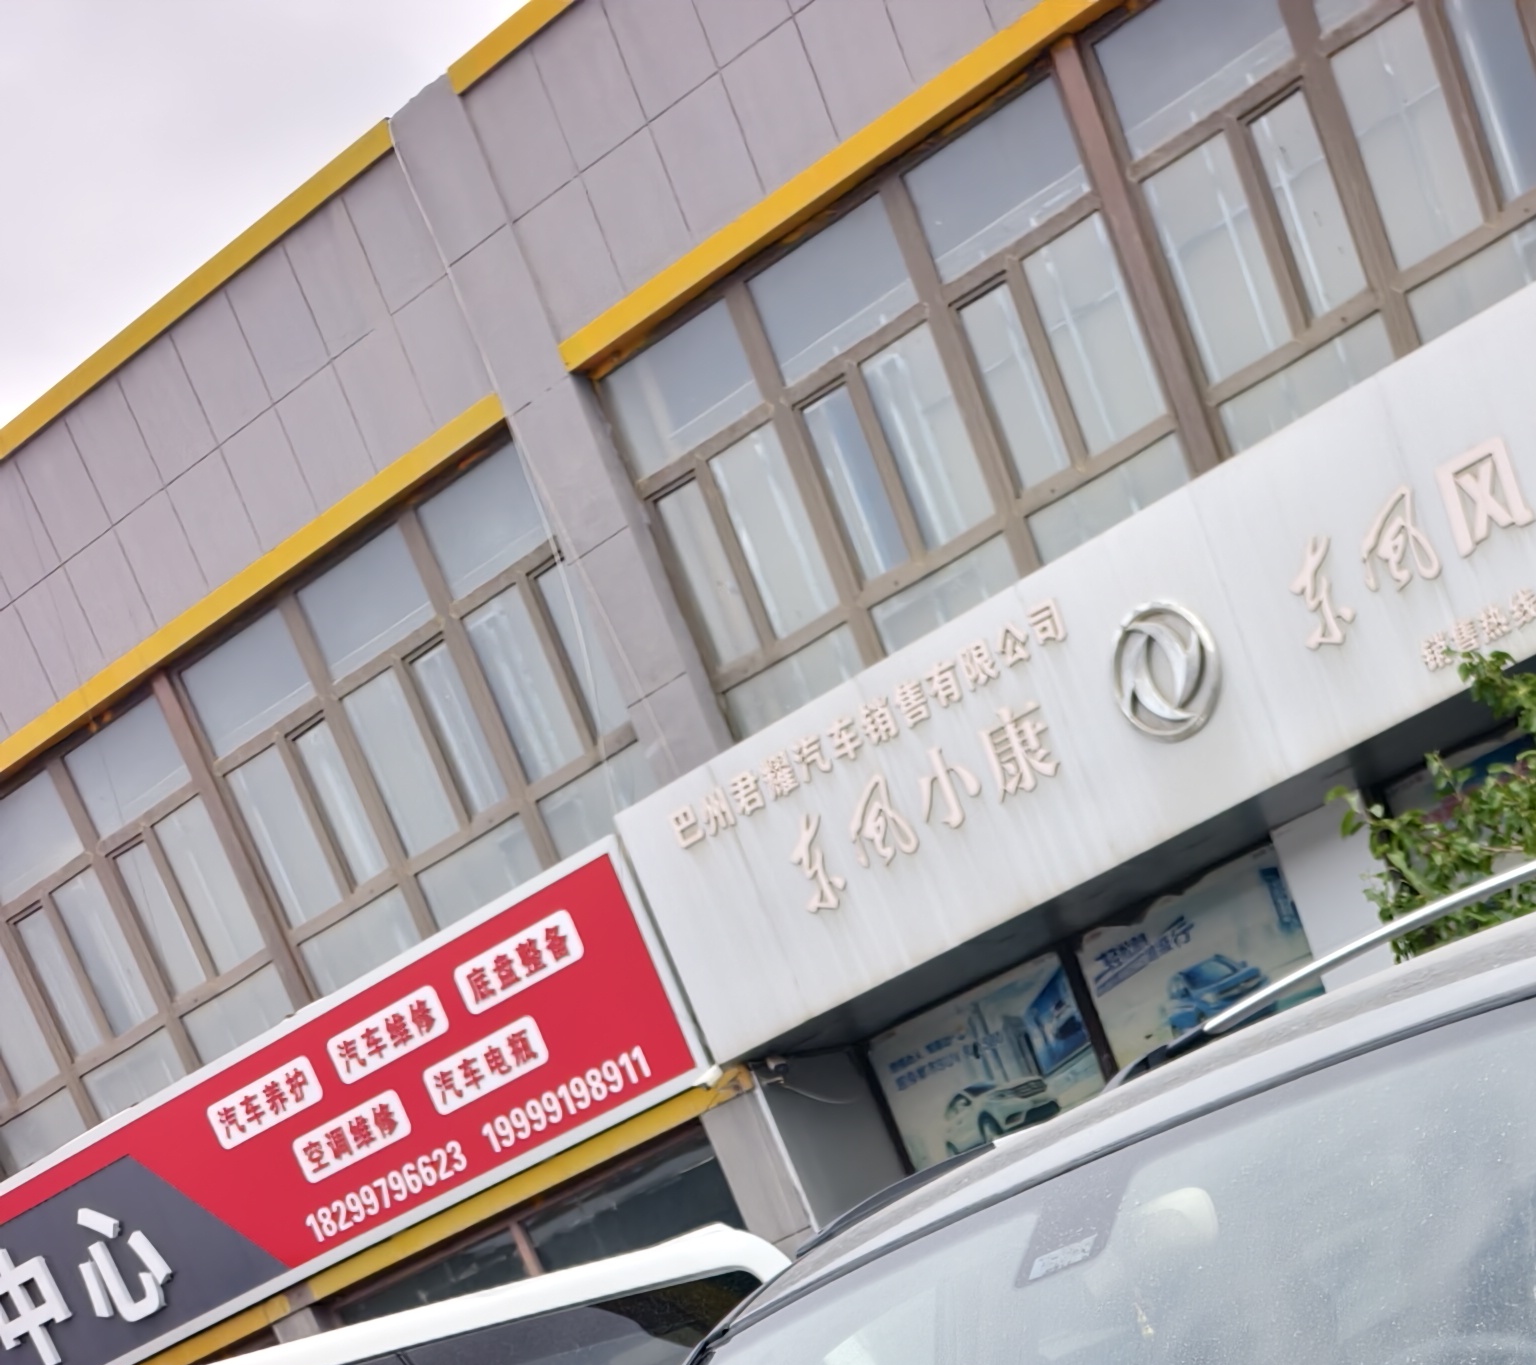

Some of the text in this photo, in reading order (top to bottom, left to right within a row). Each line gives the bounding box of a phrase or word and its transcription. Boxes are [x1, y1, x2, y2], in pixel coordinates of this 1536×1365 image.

[668, 598, 1068, 849] 巴州君耀汽车销售有限公司
[790, 700, 1060, 914] 东风小康
[336, 998, 438, 1075] 汽车维修
[433, 1027, 540, 1106] 汽车电瓶
[216, 1067, 311, 1140] 汽车养护
[302, 1102, 401, 1174] 空调维修
[305, 1045, 652, 1243] 18299796623 19999198911
